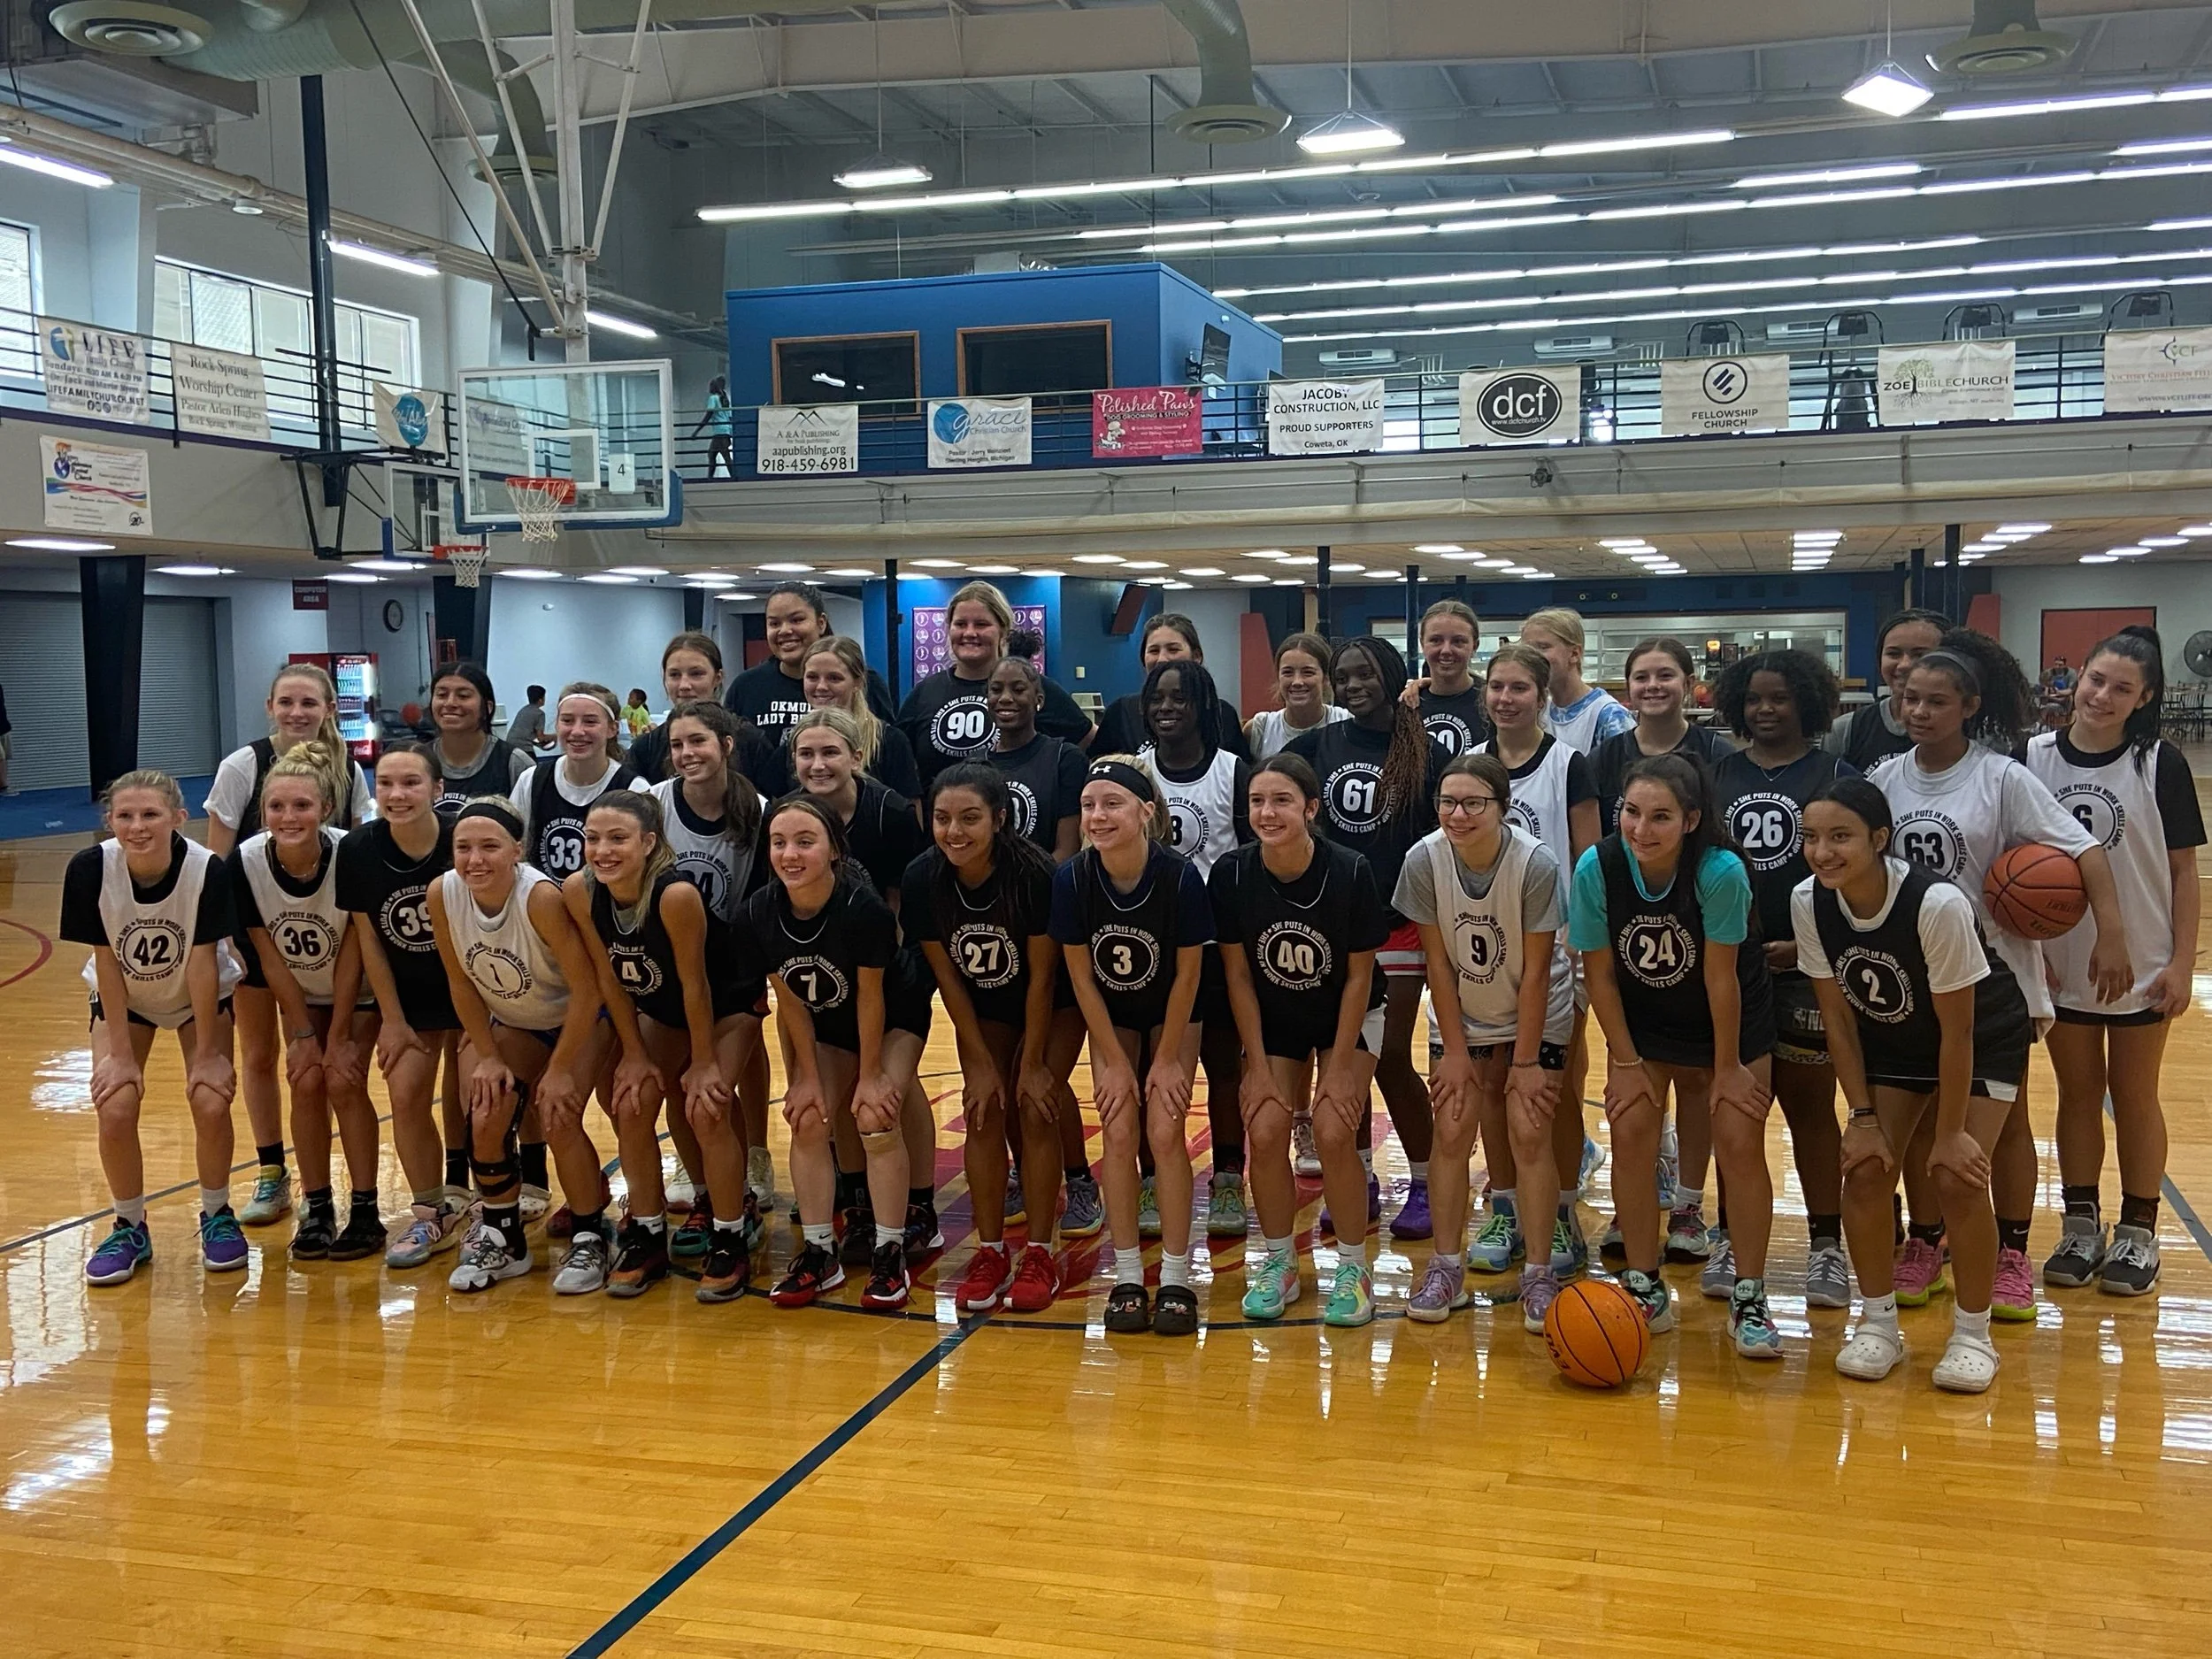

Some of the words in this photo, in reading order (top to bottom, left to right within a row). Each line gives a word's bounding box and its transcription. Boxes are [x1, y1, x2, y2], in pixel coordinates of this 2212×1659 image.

[82, 333, 134, 358] LIFE
[189, 355, 214, 371] Rock
[217, 360, 249, 379] Spring
[180, 375, 223, 397] Worship
[227, 383, 258, 400] Center
[1884, 381, 1910, 390] ZOE
[181, 398, 205, 411] Pastor
[1097, 395, 1157, 413] Polished
[1158, 391, 1196, 410] Paws
[1274, 402, 1359, 413] CONSTRUCTION,
[1363, 400, 1379, 410] LLC
[1493, 385, 1547, 419] dcf
[1692, 409, 1758, 419] FELLOWSHIP
[1704, 419, 1747, 428] CHURCH
[1280, 424, 1311, 433] PROUD
[1315, 421, 1373, 431] SUPPORTERS
[772, 446, 846, 457] aapublishing.org
[618, 464, 626, 476] 4
[762, 457, 854, 472] 918-459-6981
[757, 713, 785, 726] LADY
[947, 710, 985, 740] 90
[1463, 728, 1472, 746] SKILLS
[1878, 754, 1892, 763] SHE
[1863, 764, 1875, 776] SHE
[1343, 779, 1376, 814] 61
[1738, 795, 1752, 803] SHE
[2059, 786, 2072, 795] SHE
[2101, 787, 2120, 805] WORK
[1028, 796, 1037, 816] SKILLS
[1327, 772, 1339, 782] SHE
[1338, 820, 1358, 833] SKILLS
[1359, 823, 1376, 833] CAMP
[1518, 800, 1536, 818] WORK
[1779, 795, 1799, 810] WORK
[1189, 802, 1204, 817] WORK
[1201, 816, 1210, 836] SKILLS
[1793, 810, 1803, 833] SKILLS
[1900, 812, 1913, 823] SHE
[1941, 814, 1959, 833] WORK
[2072, 804, 2092, 834] 6
[2115, 805, 2125, 827] SKILLS
[1724, 805, 1735, 819] SHE
[1769, 856, 1787, 870] CAMP
[1741, 810, 1783, 849] 26
[2111, 828, 2124, 847] CAMP
[550, 836, 581, 870] 33
[1792, 834, 1804, 854] CAMP
[1904, 832, 1945, 869] 63
[1954, 832, 1967, 856] SKILLS
[714, 858, 729, 873] WORK
[1955, 856, 1967, 876] CAMP
[402, 886, 419, 895] PUTS
[398, 901, 434, 936] 39
[1284, 921, 1303, 931] PUTS
[1302, 925, 1311, 934] IN
[284, 927, 320, 956] 36
[1138, 928, 1156, 943] WORK
[1258, 931, 1270, 944] SHE
[1678, 929, 1695, 949] SKILLS
[133, 934, 170, 966] 42
[965, 940, 1000, 973] 27
[1277, 941, 1314, 974] 40
[1471, 933, 1487, 966] 9
[1639, 930, 1676, 970] 24
[785, 957, 796, 967] SHE
[818, 956, 835, 972] WORK
[1113, 945, 1132, 975] 3
[1846, 946, 1859, 956] SHE
[1881, 952, 1901, 970] WORK
[1897, 969, 1912, 991] SKILLS
[1106, 980, 1128, 991] SKILLS
[1129, 980, 1146, 990] CAMP
[1263, 968, 1280, 985] WORK
[1280, 979, 1303, 991] SKILLS
[1462, 972, 1484, 984] SKILLS
[1666, 972, 1685, 987] CAMP
[800, 972, 817, 1002] 7
[1862, 969, 1887, 1004] 2
